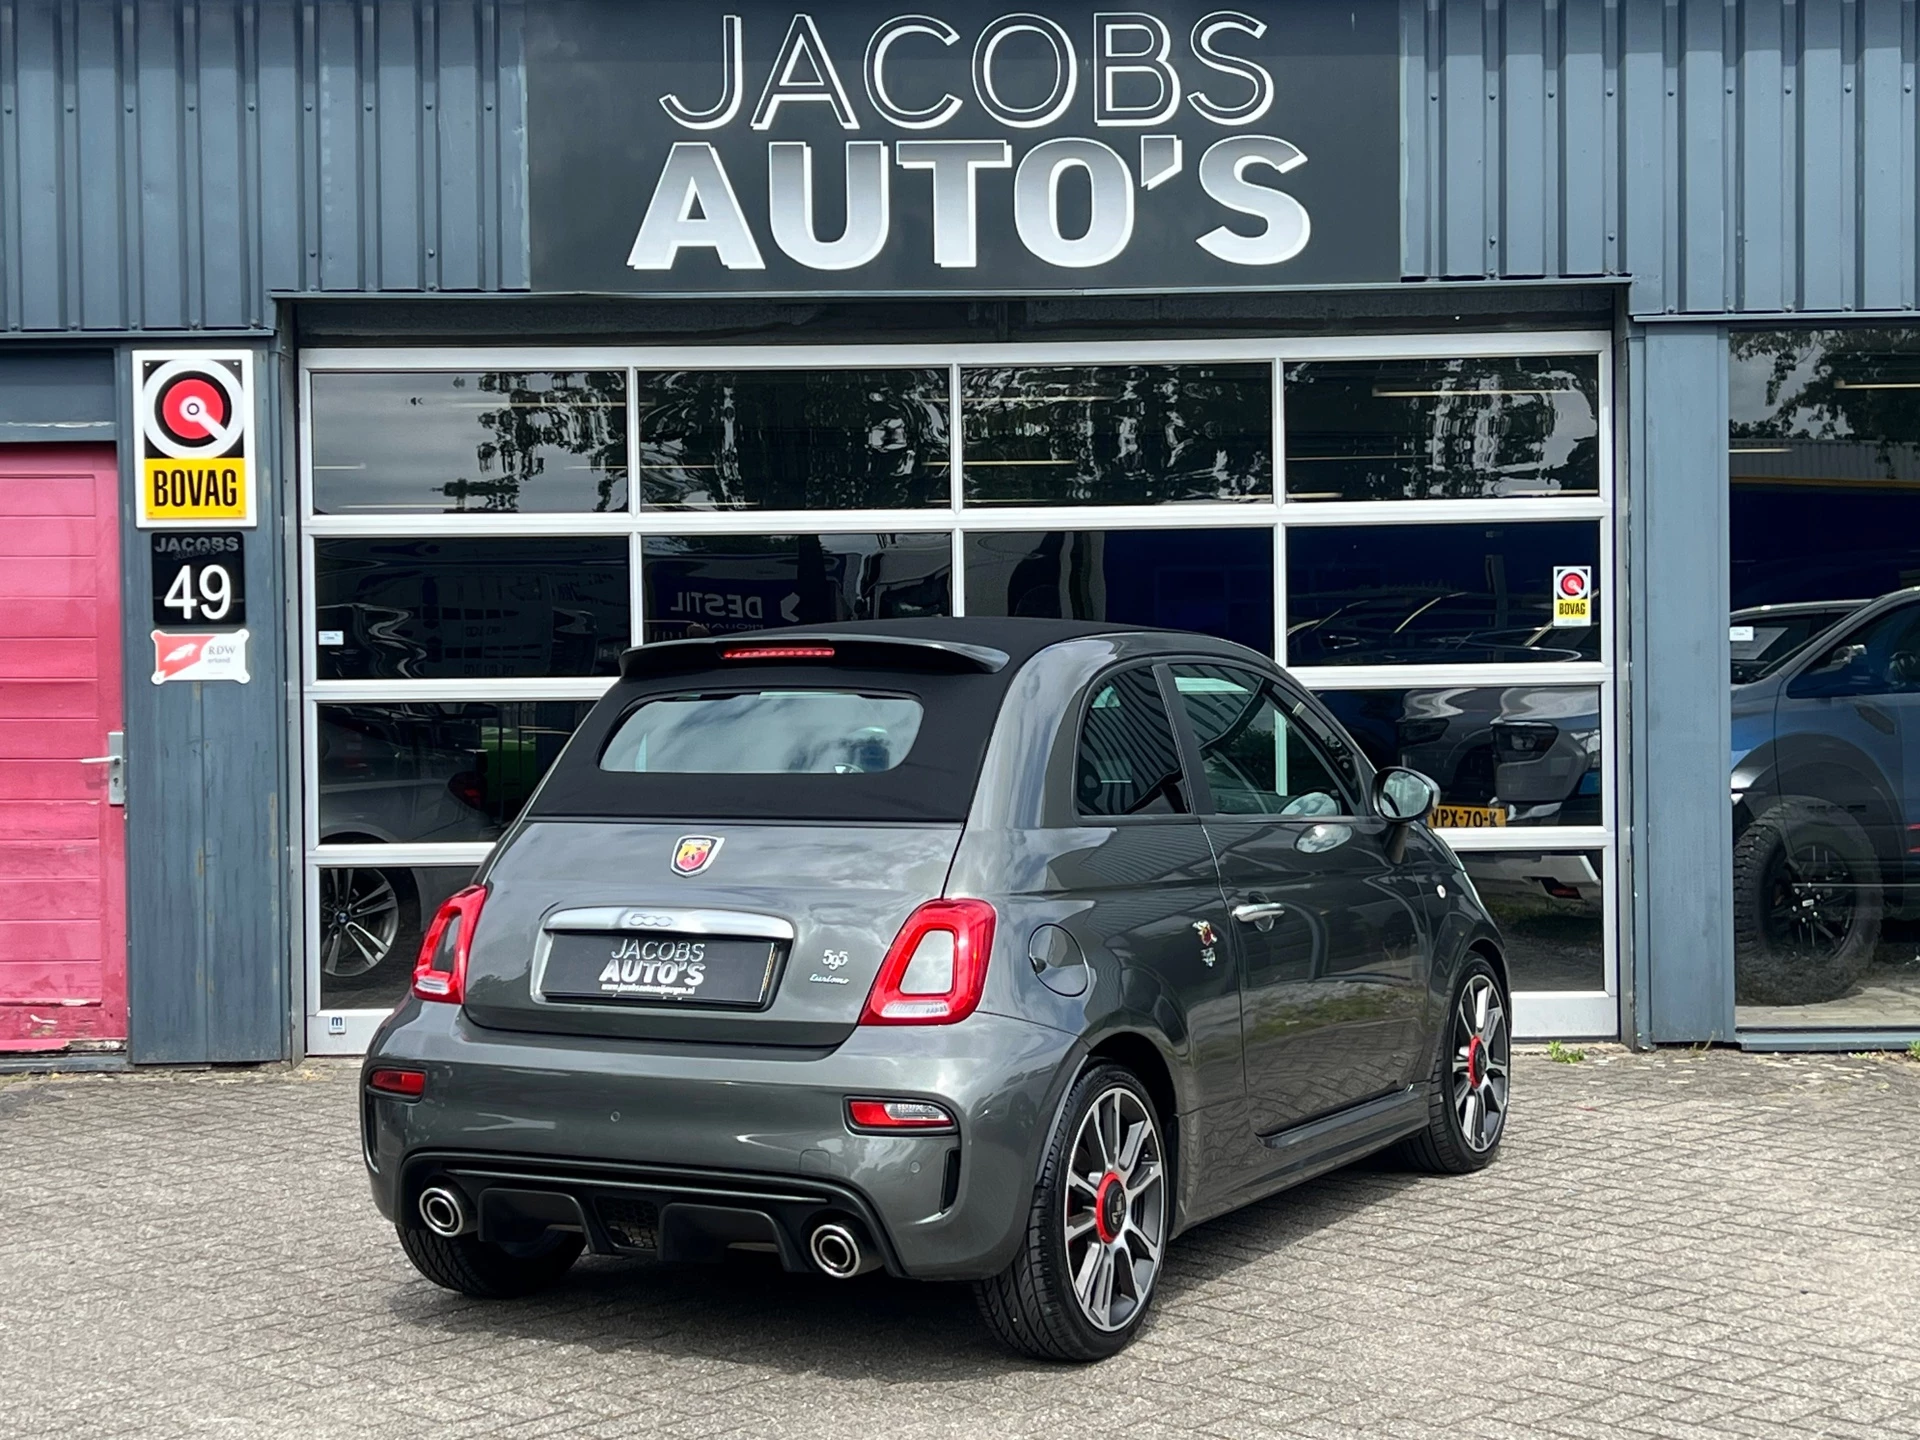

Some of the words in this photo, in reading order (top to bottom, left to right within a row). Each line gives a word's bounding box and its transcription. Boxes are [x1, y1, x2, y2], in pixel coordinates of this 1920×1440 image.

[659, 11, 1274, 129] JACOBS
[626, 134, 1312, 271] AUTO'S
[153, 468, 238, 508] BOVAG
[154, 536, 239, 552] JACOBS
[163, 563, 231, 620] 49
[1558, 602, 1586, 615] BOVAG
[208, 645, 236, 656] RDW
[1431, 808, 1498, 828] VPX-70-K
[628, 912, 674, 927] 500
[611, 938, 706, 962] JACOBS
[822, 949, 849, 970] 595
[599, 960, 706, 986] AUTO'S
